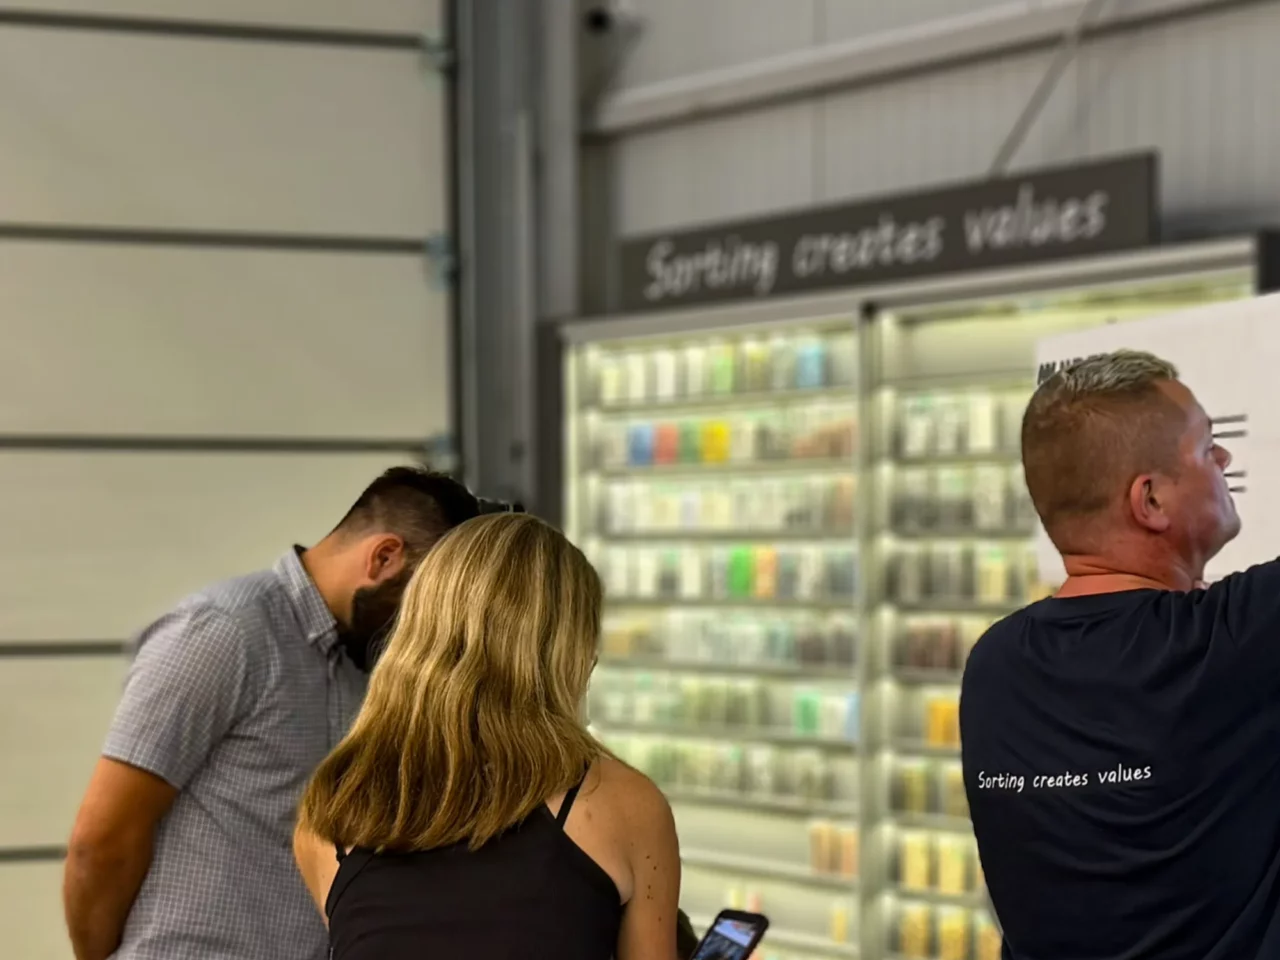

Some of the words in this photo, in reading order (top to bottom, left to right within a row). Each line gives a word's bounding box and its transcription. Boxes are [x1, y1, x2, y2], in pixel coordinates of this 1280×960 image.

[645, 237, 778, 298] Sorting
[793, 210, 943, 276] creates
[963, 185, 1107, 251] values
[978, 771, 1025, 793] Sorting
[1033, 770, 1089, 788] creates
[1098, 763, 1152, 784] values
